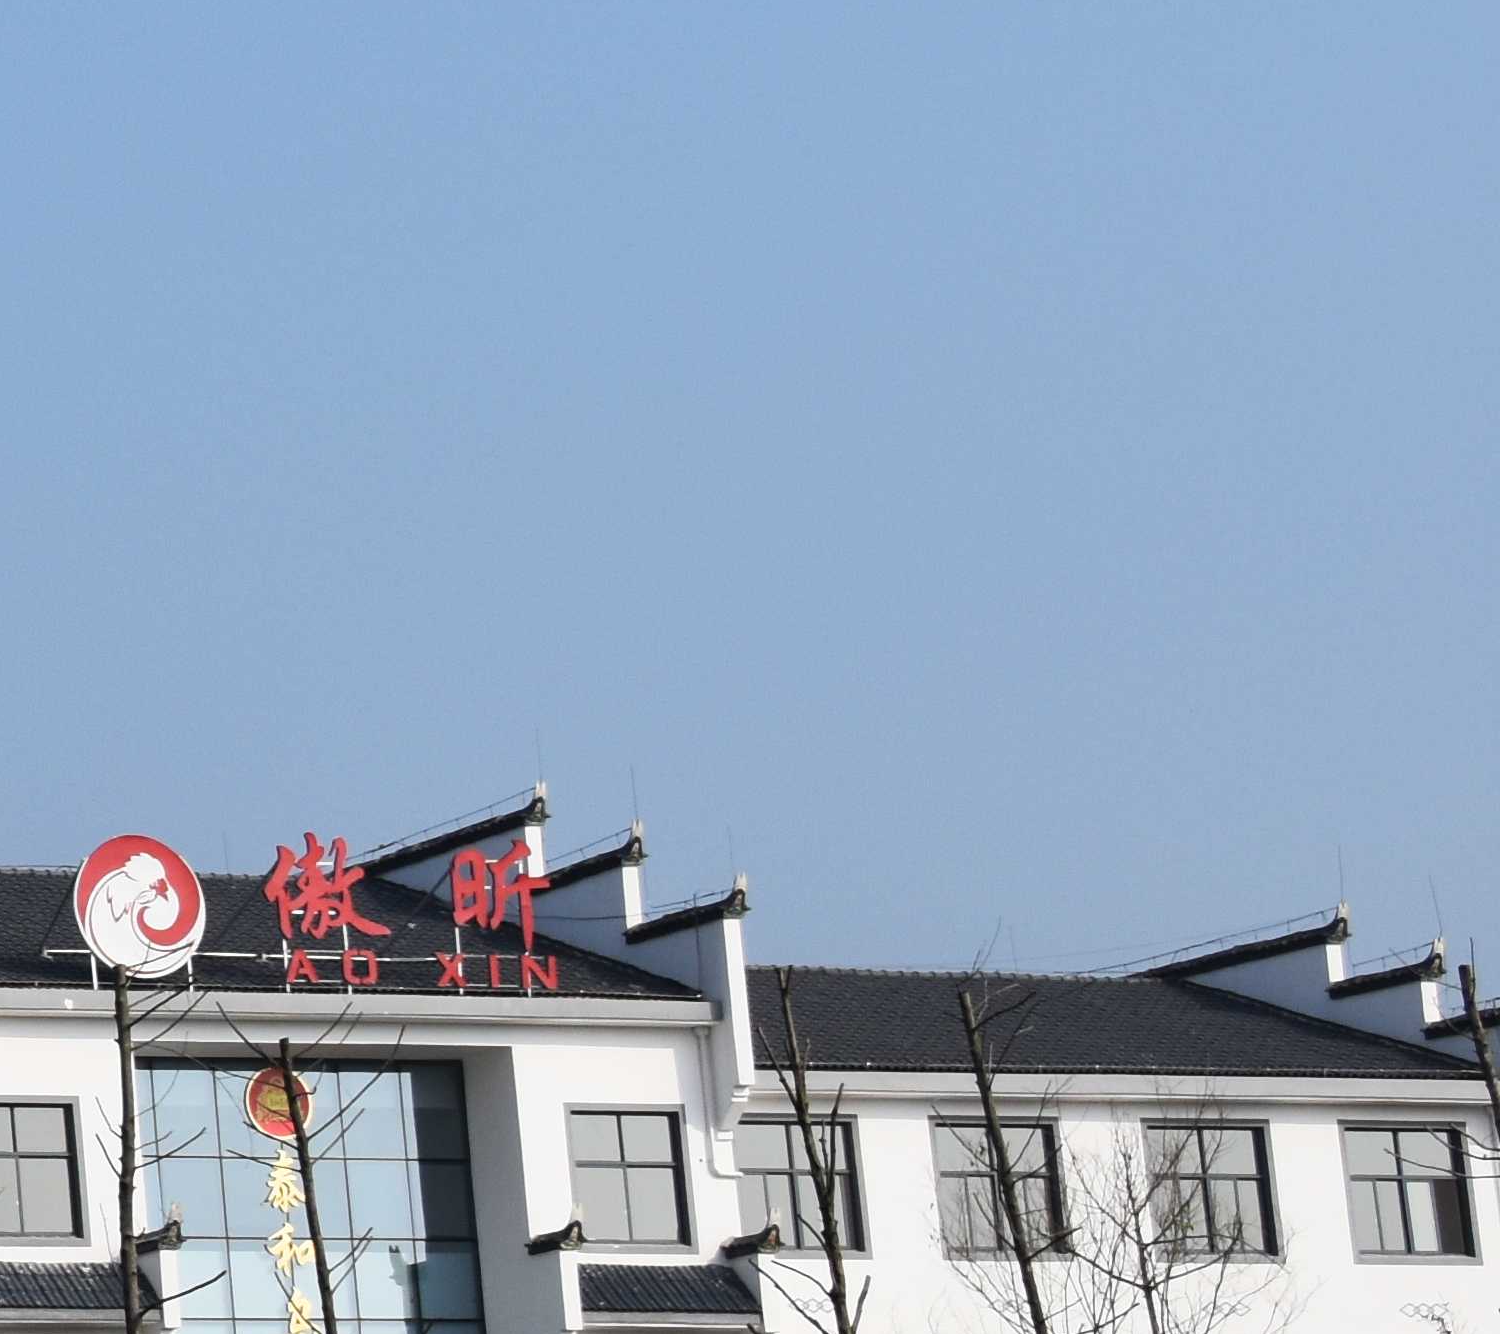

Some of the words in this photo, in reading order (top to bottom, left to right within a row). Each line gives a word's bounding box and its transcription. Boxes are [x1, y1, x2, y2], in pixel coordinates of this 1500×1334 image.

[263, 832, 550, 953] 傲昕
[287, 949, 379, 986] AO
[435, 951, 559, 990] XIN
